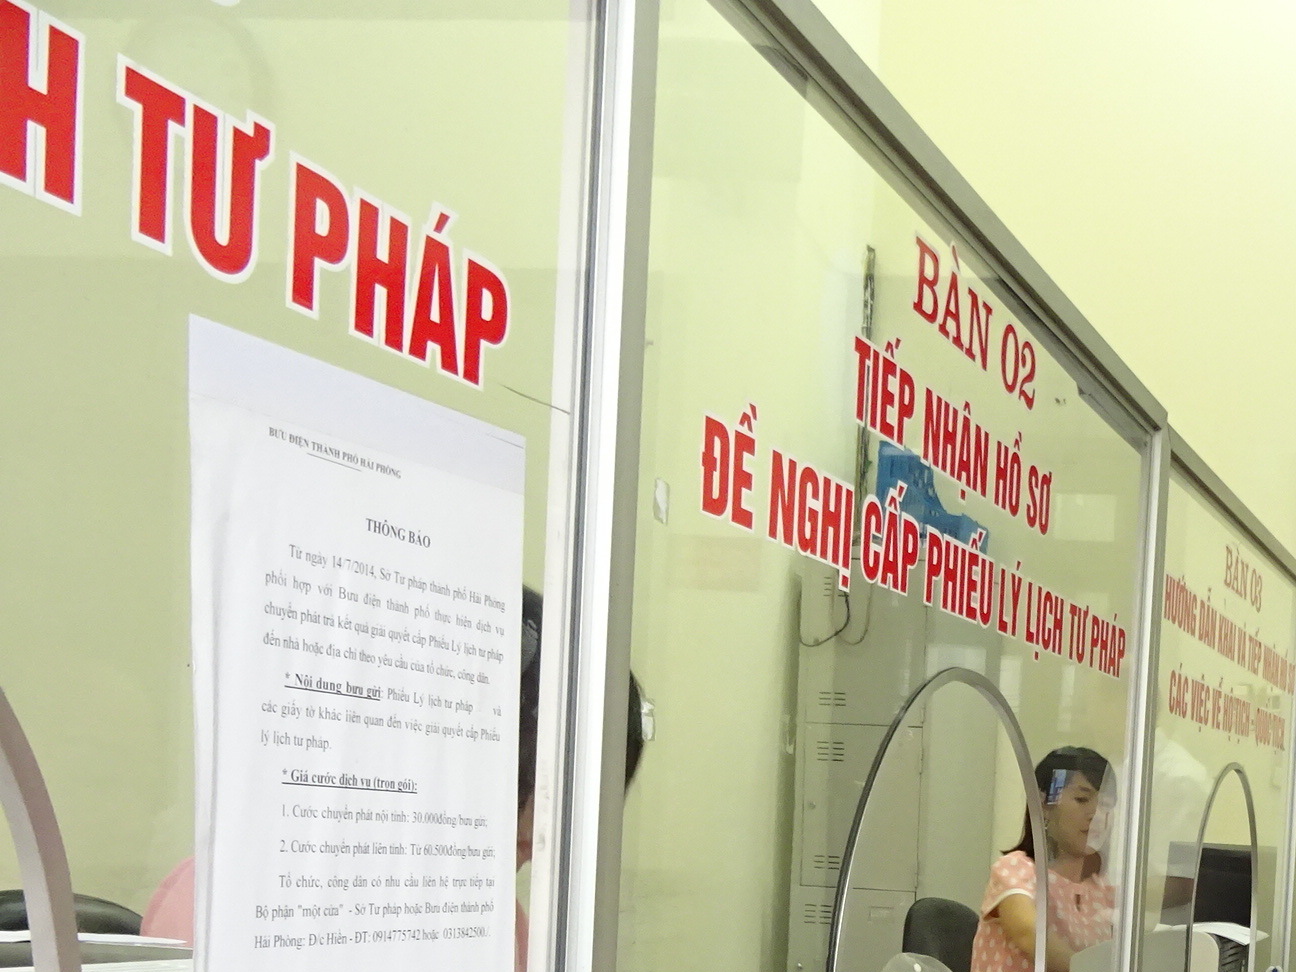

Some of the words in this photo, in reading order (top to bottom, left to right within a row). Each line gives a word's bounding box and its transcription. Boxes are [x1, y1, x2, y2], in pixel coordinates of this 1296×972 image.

[120, 58, 273, 280] TƯ
[288, 154, 510, 389] PHÁP
[913, 236, 992, 371] BÀN
[1001, 324, 1037, 410] 02
[854, 335, 916, 447] TIẾP
[921, 387, 990, 501] NHẬN
[994, 431, 1024, 517] HỒ
[1026, 465, 1052, 535] SƠ
[365, 518, 406, 542] THÔNG
[408, 528, 431, 548] BÁO
[701, 402, 758, 530] ĐỀ
[767, 447, 854, 593] NGHỊ
[860, 480, 919, 595] CẤP
[923, 529, 995, 628] PHIẾU
[997, 560, 1023, 637] LÝ
[1025, 581, 1063, 661] LỊCH
[1068, 603, 1090, 665] TƯ
[1090, 614, 1126, 679] PHÁP
[289, 544, 302, 559] Từ
[305, 552, 328, 569] ngày
[394, 571, 405, 585] Tư
[1224, 545, 1248, 600] BÀN
[1250, 568, 1263, 613] 03
[265, 568, 286, 586] phối
[293, 576, 311, 595] hợp
[318, 584, 332, 597] với
[339, 587, 358, 602] Bưu
[363, 593, 381, 609] điện
[386, 599, 409, 614] thành
[264, 601, 297, 620] chuyển
[300, 609, 320, 624] phát
[323, 614, 334, 627] trả
[338, 614, 352, 630] kết
[354, 622, 369, 635] quả
[1164, 574, 1197, 638] HƯỚNG
[1199, 587, 1217, 650] DẪN
[1217, 613, 1236, 661] KHAI
[1248, 627, 1261, 676] TIẾP
[263, 629, 280, 647] đến
[283, 636, 299, 650] nhà
[302, 639, 323, 656] hoặc
[326, 644, 341, 659] địa
[316, 677, 342, 694] dung
[346, 681, 363, 695] bưu
[387, 687, 410, 702] Phiếu
[413, 692, 424, 707] Lý
[493, 706, 502, 716] và
[1169, 662, 1188, 719] CÁC
[1191, 673, 1210, 733] VIỆC
[1212, 677, 1223, 730] VỀ
[261, 700, 277, 713] các
[281, 700, 301, 720] giấy
[305, 706, 315, 718] tờ
[318, 706, 342, 721] khác
[364, 716, 384, 728] quan
[387, 714, 401, 729] đến
[405, 719, 422, 733] việc
[261, 729, 269, 746] lý
[273, 731, 290, 746] lịch
[294, 736, 303, 746] tư
[291, 769, 309, 783] Giá
[311, 772, 336, 784] cước
[292, 805, 318, 818] Cước
[321, 804, 353, 823] chuyển
[356, 809, 373, 823] phát
[375, 810, 388, 823] nội
[280, 839, 288, 852] 2.
[291, 840, 316, 853] Cước
[319, 838, 350, 857] chuyển
[353, 841, 370, 857] phát
[372, 842, 387, 855] liên
[279, 872, 292, 888] Tổ
[296, 875, 323, 889] chức,
[327, 875, 349, 890] công
[352, 876, 368, 887] dân
[371, 876, 381, 887] có
[385, 876, 400, 887] nhu
[404, 872, 419, 887] cầu
[256, 905, 269, 920] Bộ
[271, 905, 294, 921] phận
[354, 903, 366, 915] Sở
[368, 903, 380, 915] Tư
[383, 902, 402, 918] pháp
[404, 903, 423, 916] hoặc
[425, 902, 440, 913] Bưu
[254, 935, 270, 948] Hải
[273, 934, 306, 950] Phòng:
[326, 928, 347, 945] Hiền
[354, 931, 371, 943] ĐT:
